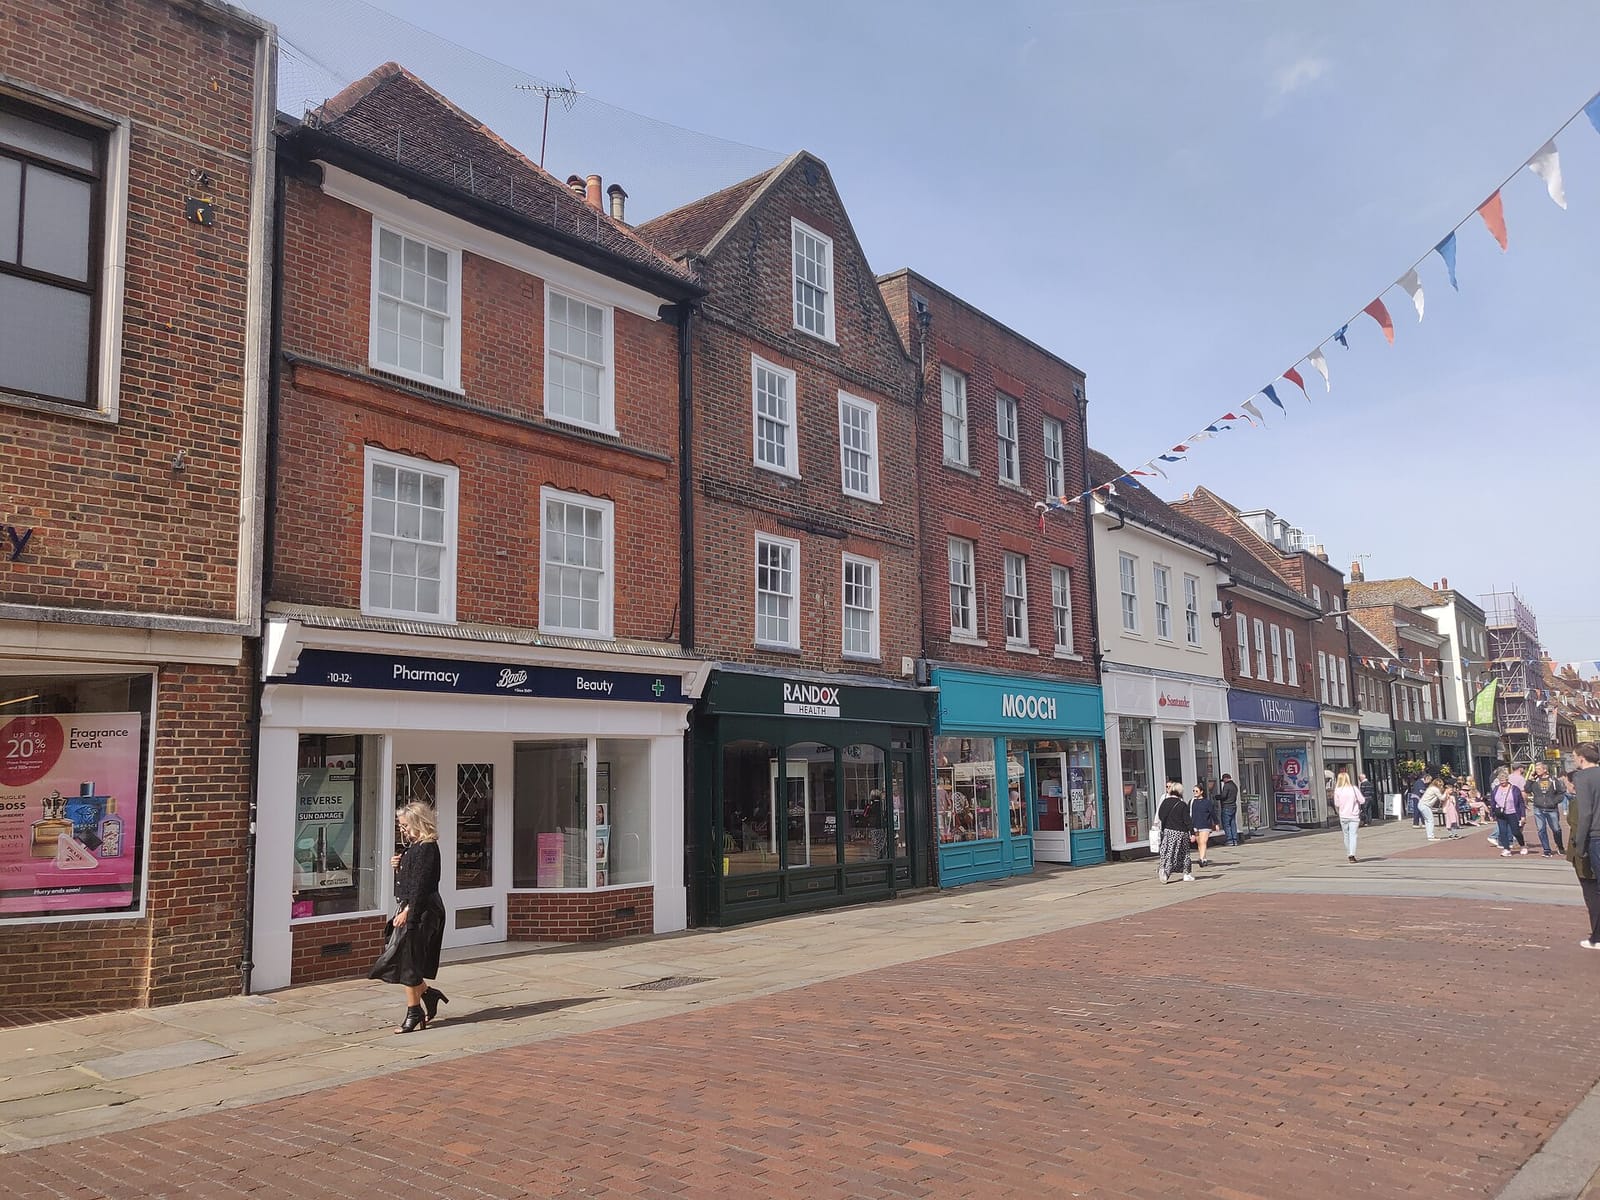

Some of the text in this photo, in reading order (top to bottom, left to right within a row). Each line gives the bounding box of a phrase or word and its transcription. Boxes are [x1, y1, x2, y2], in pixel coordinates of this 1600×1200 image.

[393, 664, 460, 686] Pharmacy
[496, 668, 528, 688] Boots
[576, 676, 614, 695] Beauty
[783, 682, 840, 705] RANDOX
[799, 705, 827, 715] HEALTH
[1002, 693, 1057, 720] MOOCH
[70, 727, 129, 740] Fragrance
[6, 738, 46, 758] 20%
[70, 738, 102, 749] Event
[1286, 764, 1298, 774] £1
[300, 796, 343, 805] REVERSE
[299, 811, 343, 820] SUN DAMAGE
[33, 888, 51, 896] Hurry
